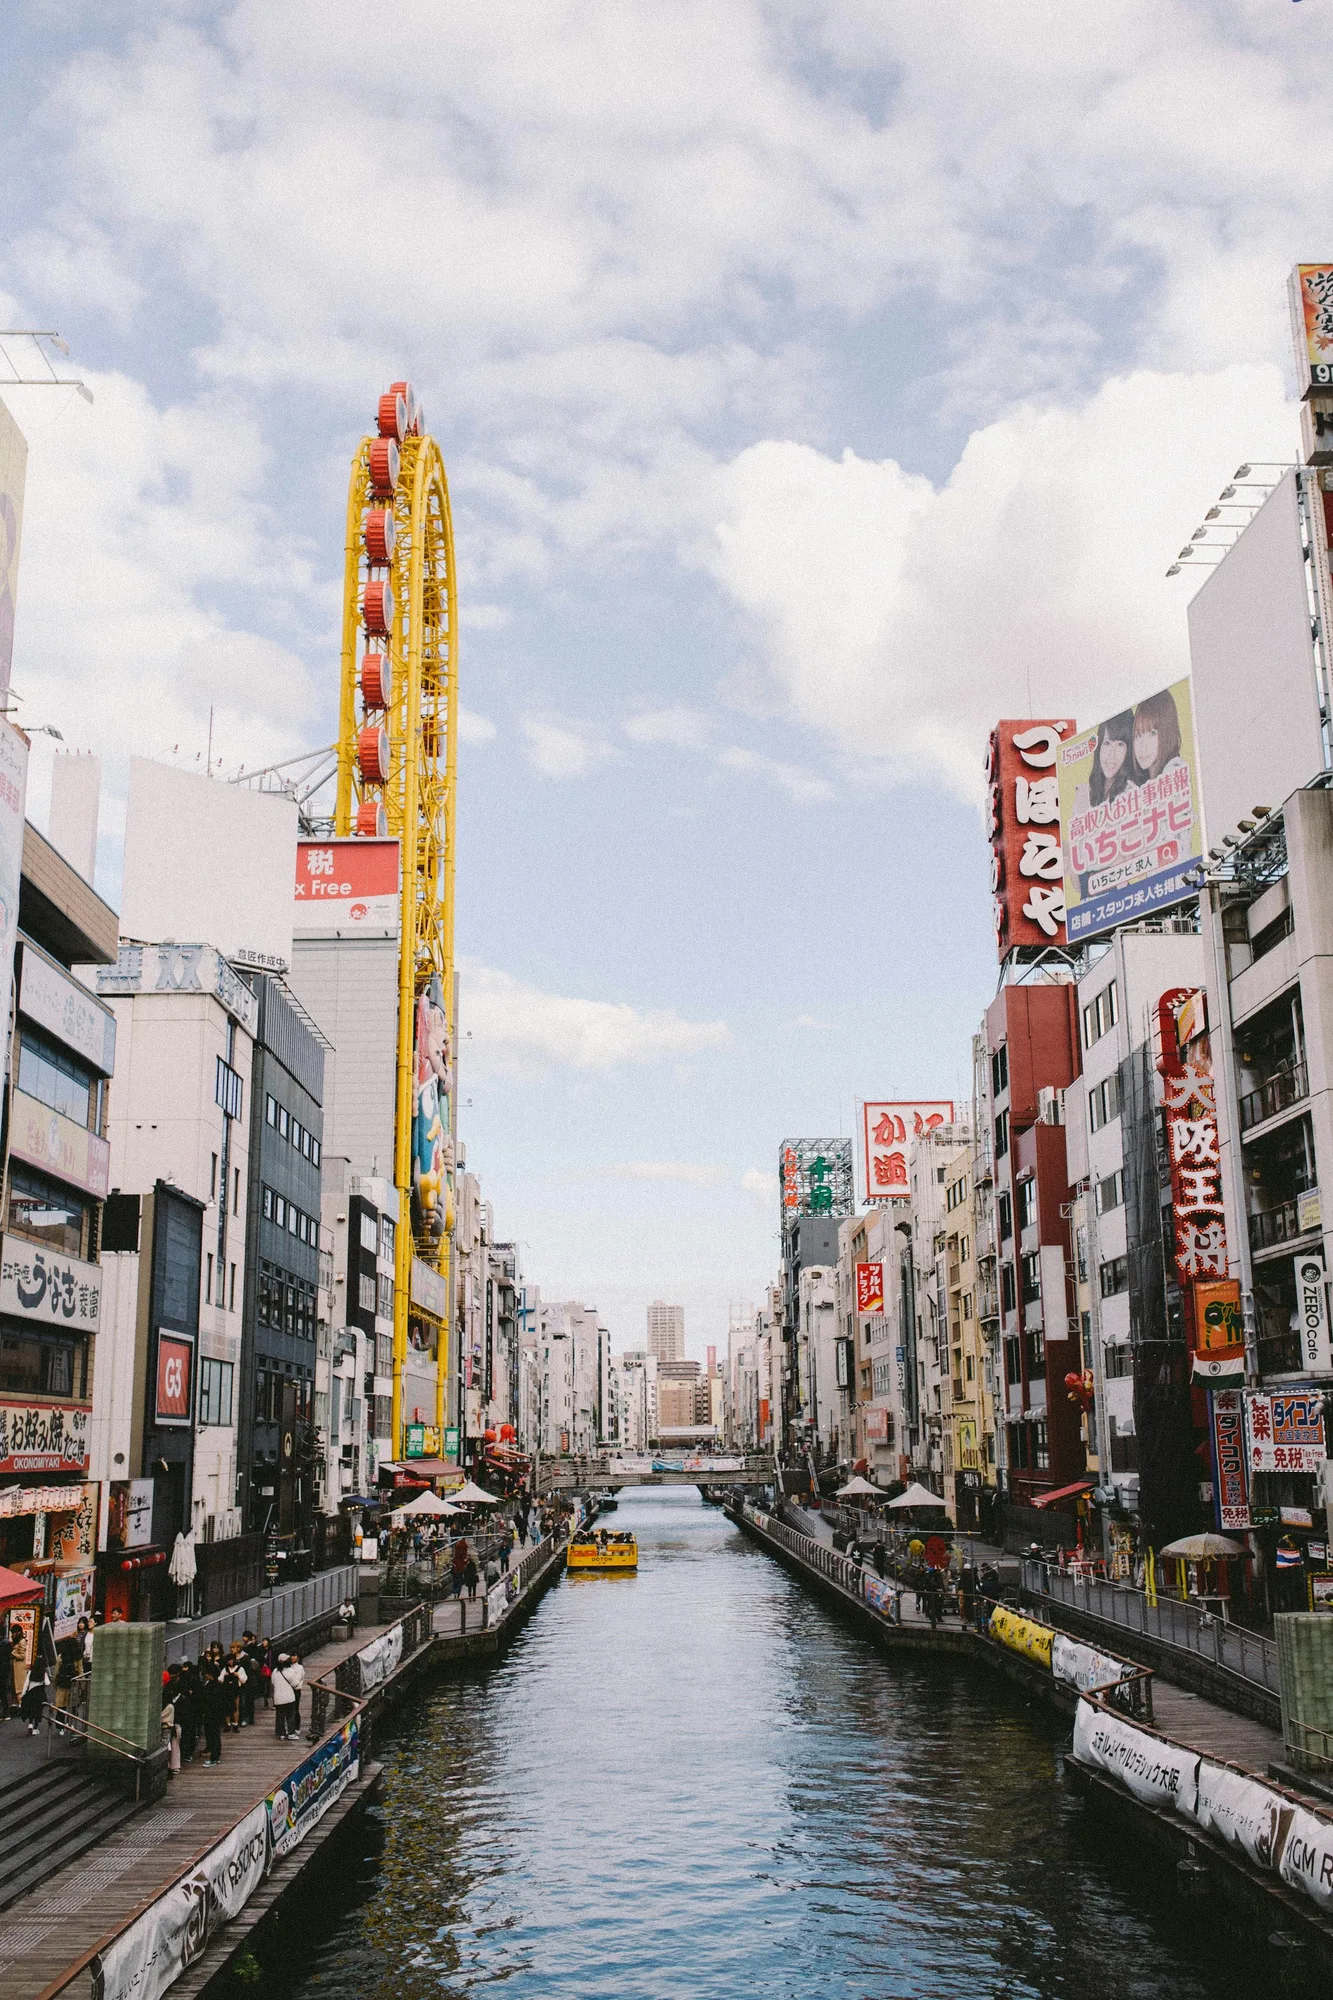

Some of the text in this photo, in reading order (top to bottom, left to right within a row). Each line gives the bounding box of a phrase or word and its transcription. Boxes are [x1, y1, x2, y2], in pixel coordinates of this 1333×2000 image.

[1069, 765, 1189, 842] 高収入お仕事情報
[1071, 789, 1192, 872] いちごナビ
[312, 880, 353, 895] Free
[1091, 855, 1154, 891] いちごナビ 求人
[1161, 1064, 1229, 1277] 大阪王将
[17, 1253, 78, 1318] うなぎ
[859, 1270, 868, 1304] ドラッグ
[869, 1265, 881, 1296] ツルハ
[1303, 1286, 1320, 1328] ZERO
[165, 1357, 183, 1398] G3
[10, 1407, 64, 1453] お好み焼
[1274, 1400, 1320, 1429] ダイコク
[13, 1456, 60, 1470] OKONOMIYAKI
[1219, 1414, 1241, 1474] ダイコク
[1273, 1447, 1308, 1469] 免税
[1222, 1507, 1248, 1519] 免税
